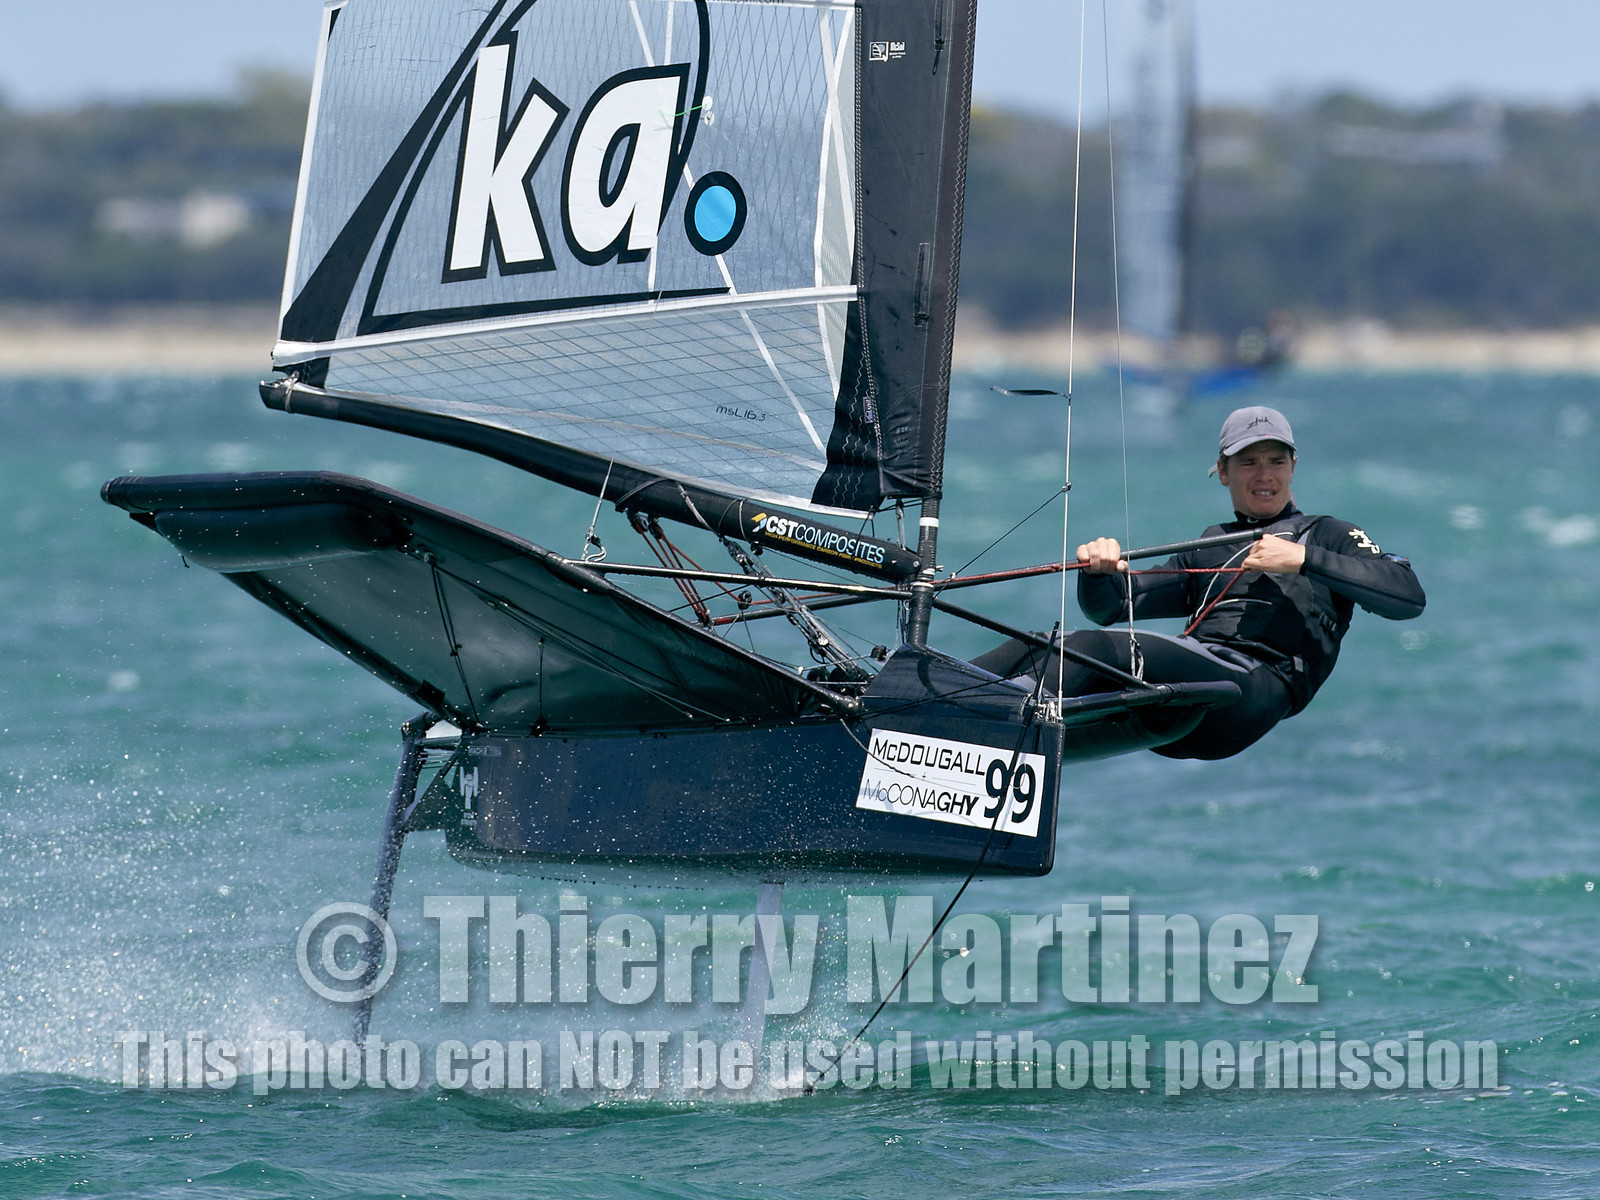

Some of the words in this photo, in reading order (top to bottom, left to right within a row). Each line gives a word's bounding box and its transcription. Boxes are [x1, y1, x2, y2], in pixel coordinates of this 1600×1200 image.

[872, 737, 986, 777] McDOUGALL
[863, 778, 980, 817] McCONAGHY
[983, 757, 1037, 824] 99
